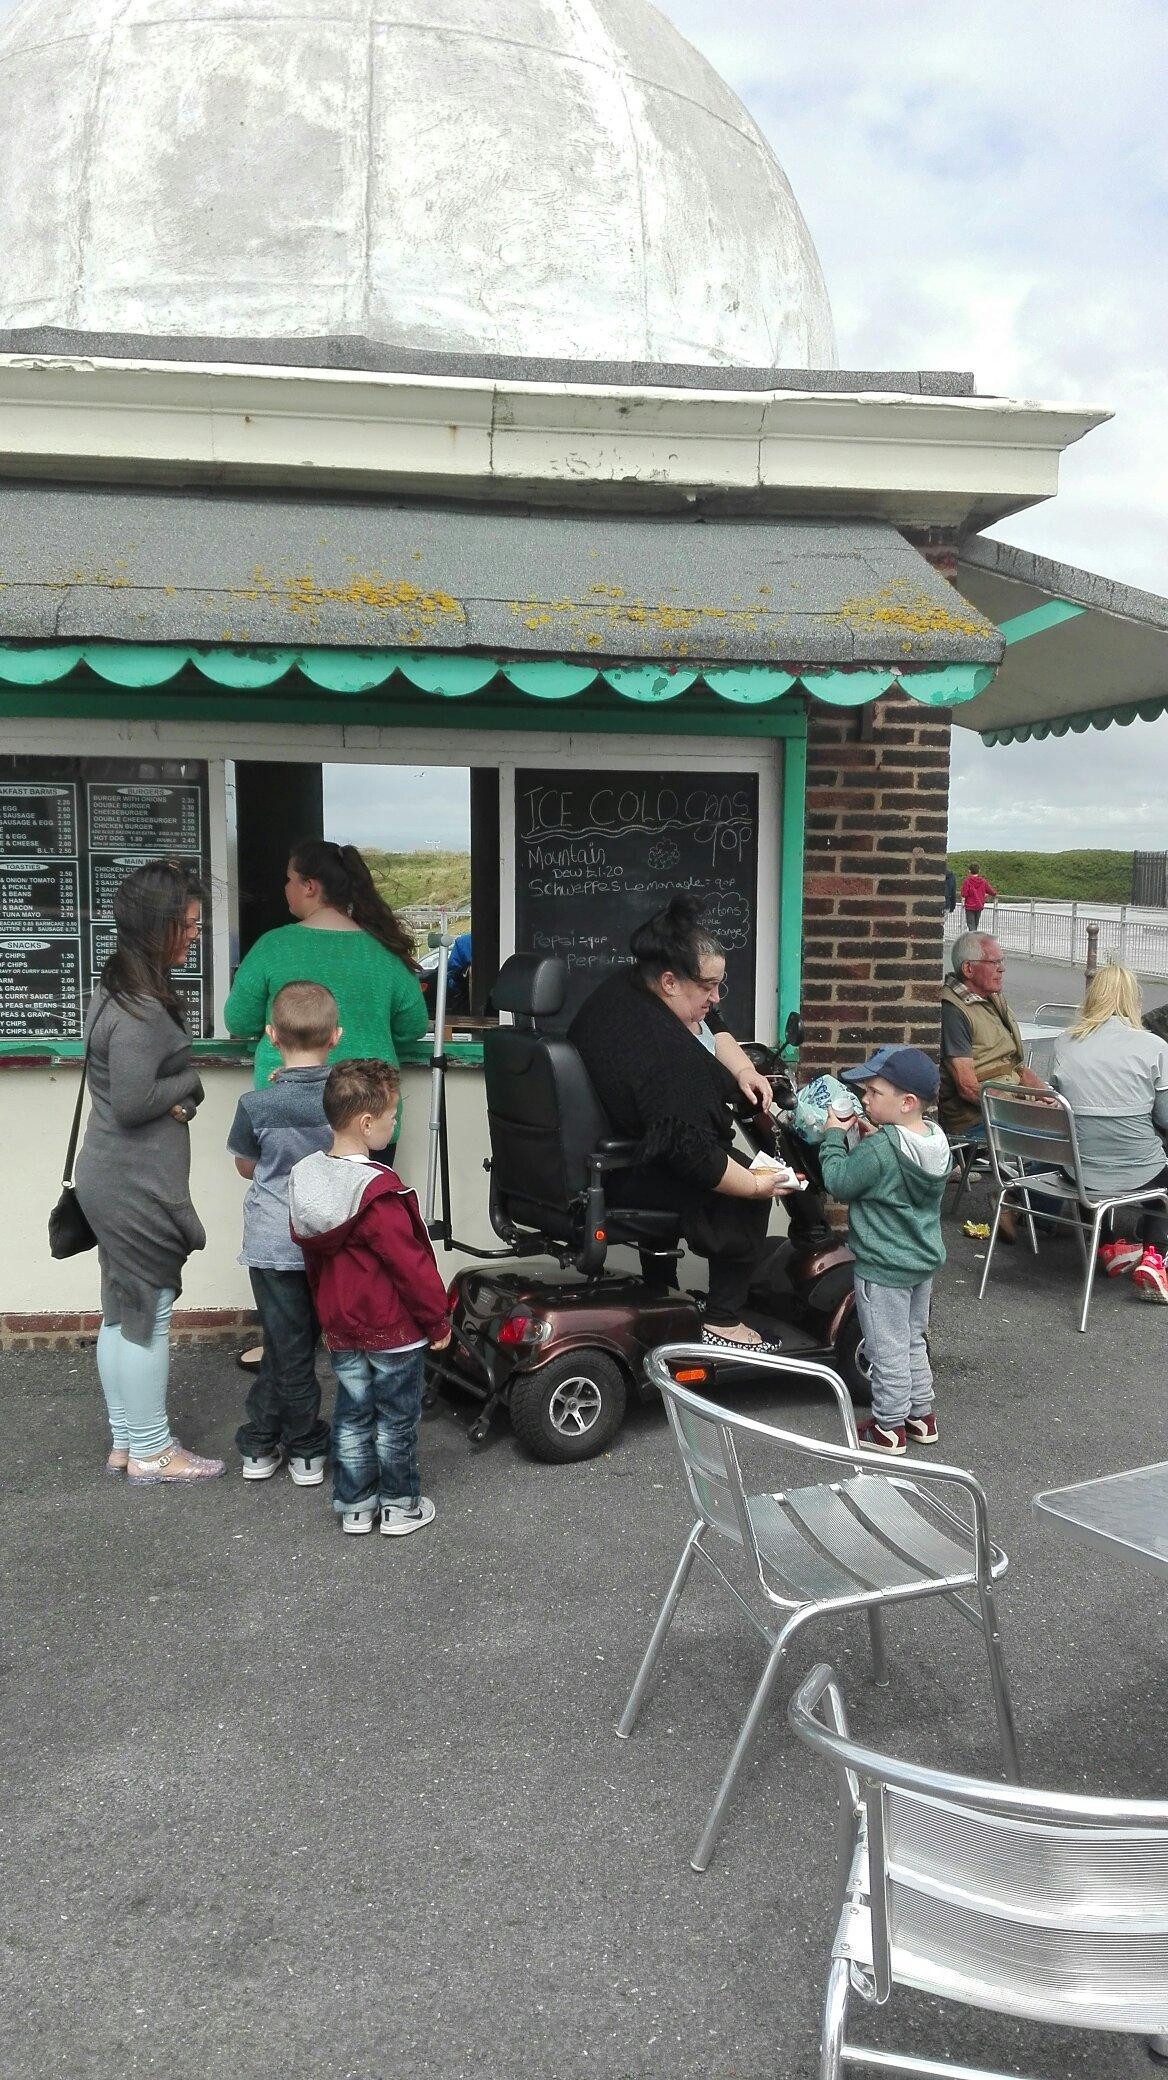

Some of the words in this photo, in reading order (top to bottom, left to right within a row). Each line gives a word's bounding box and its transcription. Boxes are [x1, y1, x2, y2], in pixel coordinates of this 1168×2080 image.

[127, 788, 164, 796] BURGERS
[523, 787, 573, 832] ICE
[590, 790, 679, 826] COLD
